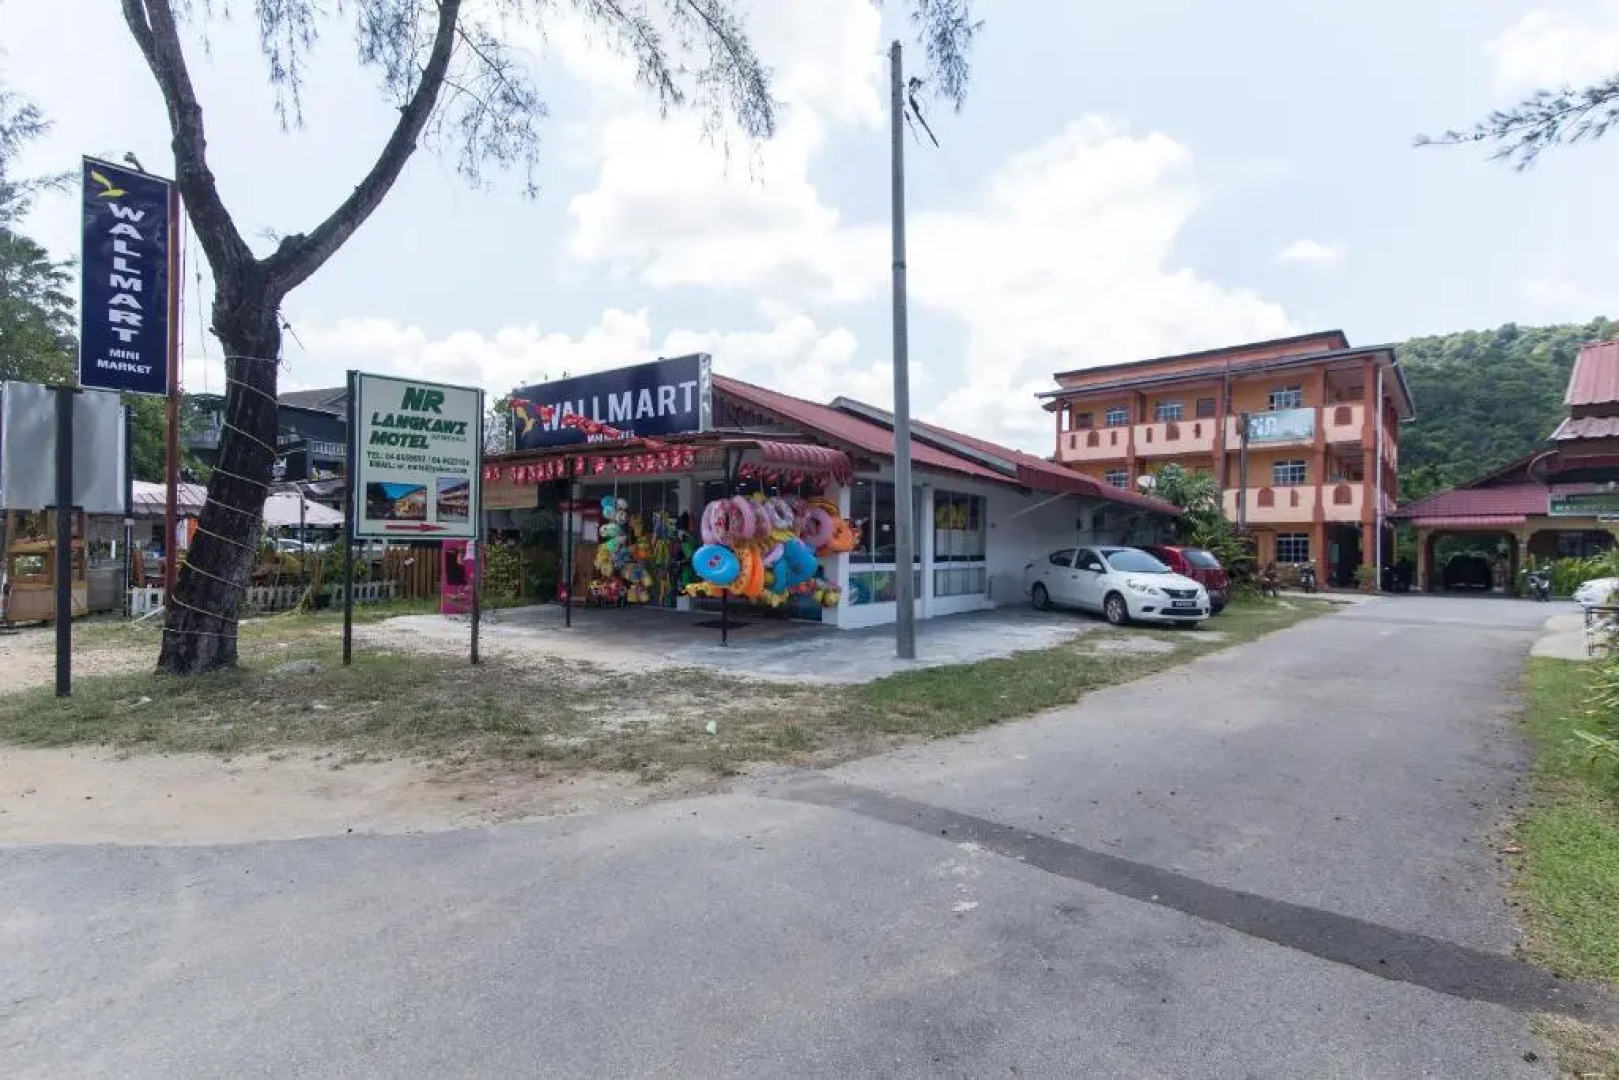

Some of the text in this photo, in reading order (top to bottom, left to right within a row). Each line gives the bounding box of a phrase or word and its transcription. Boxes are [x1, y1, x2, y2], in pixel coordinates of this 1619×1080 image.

[108, 202, 145, 343] WALLMART
[109, 348, 140, 360] MINI
[97, 358, 152, 374] MARKET
[401, 386, 445, 414] NR
[371, 412, 468, 436] LANGKAWI
[369, 430, 430, 450] MOTEL
